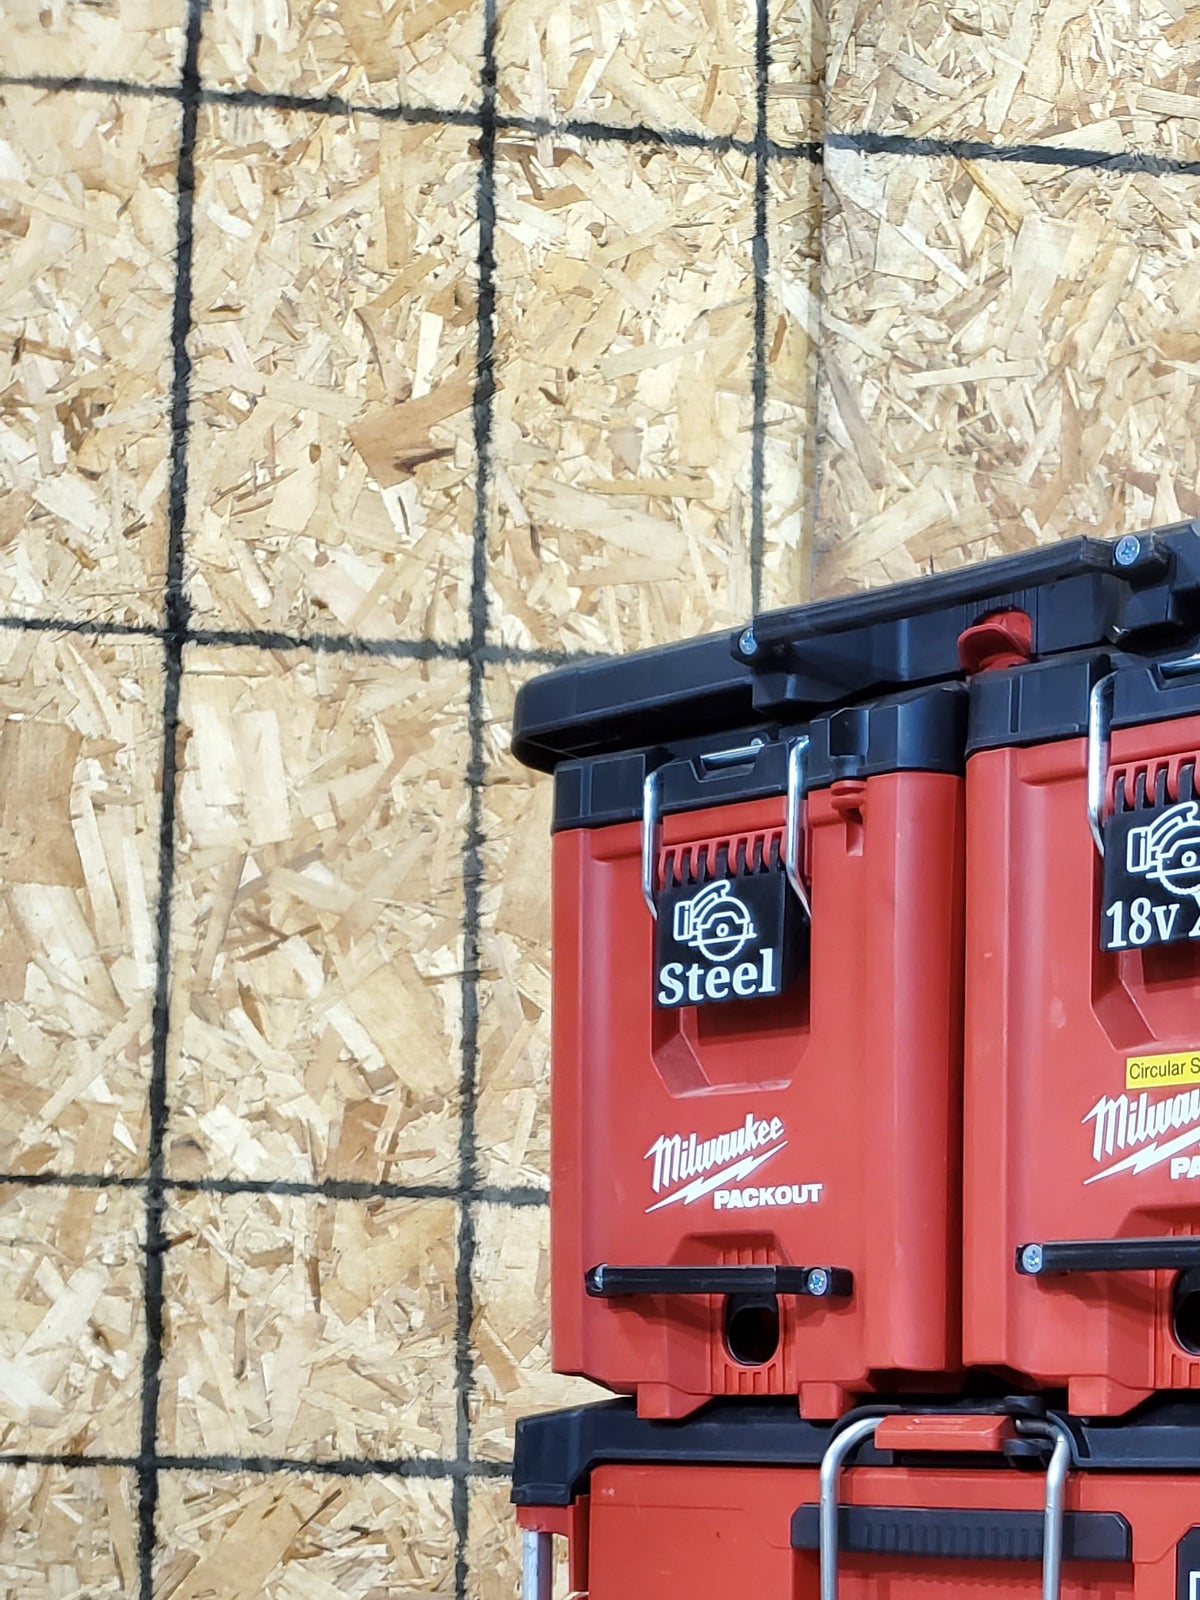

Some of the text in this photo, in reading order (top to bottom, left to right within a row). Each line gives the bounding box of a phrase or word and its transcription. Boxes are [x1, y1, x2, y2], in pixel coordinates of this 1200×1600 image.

[1106, 896, 1180, 949] 18v
[658, 948, 777, 1005] Steel
[1129, 1059, 1187, 1080] Circular
[644, 1113, 785, 1194] Milwaukee
[713, 1183, 823, 1211] PACKOUT
